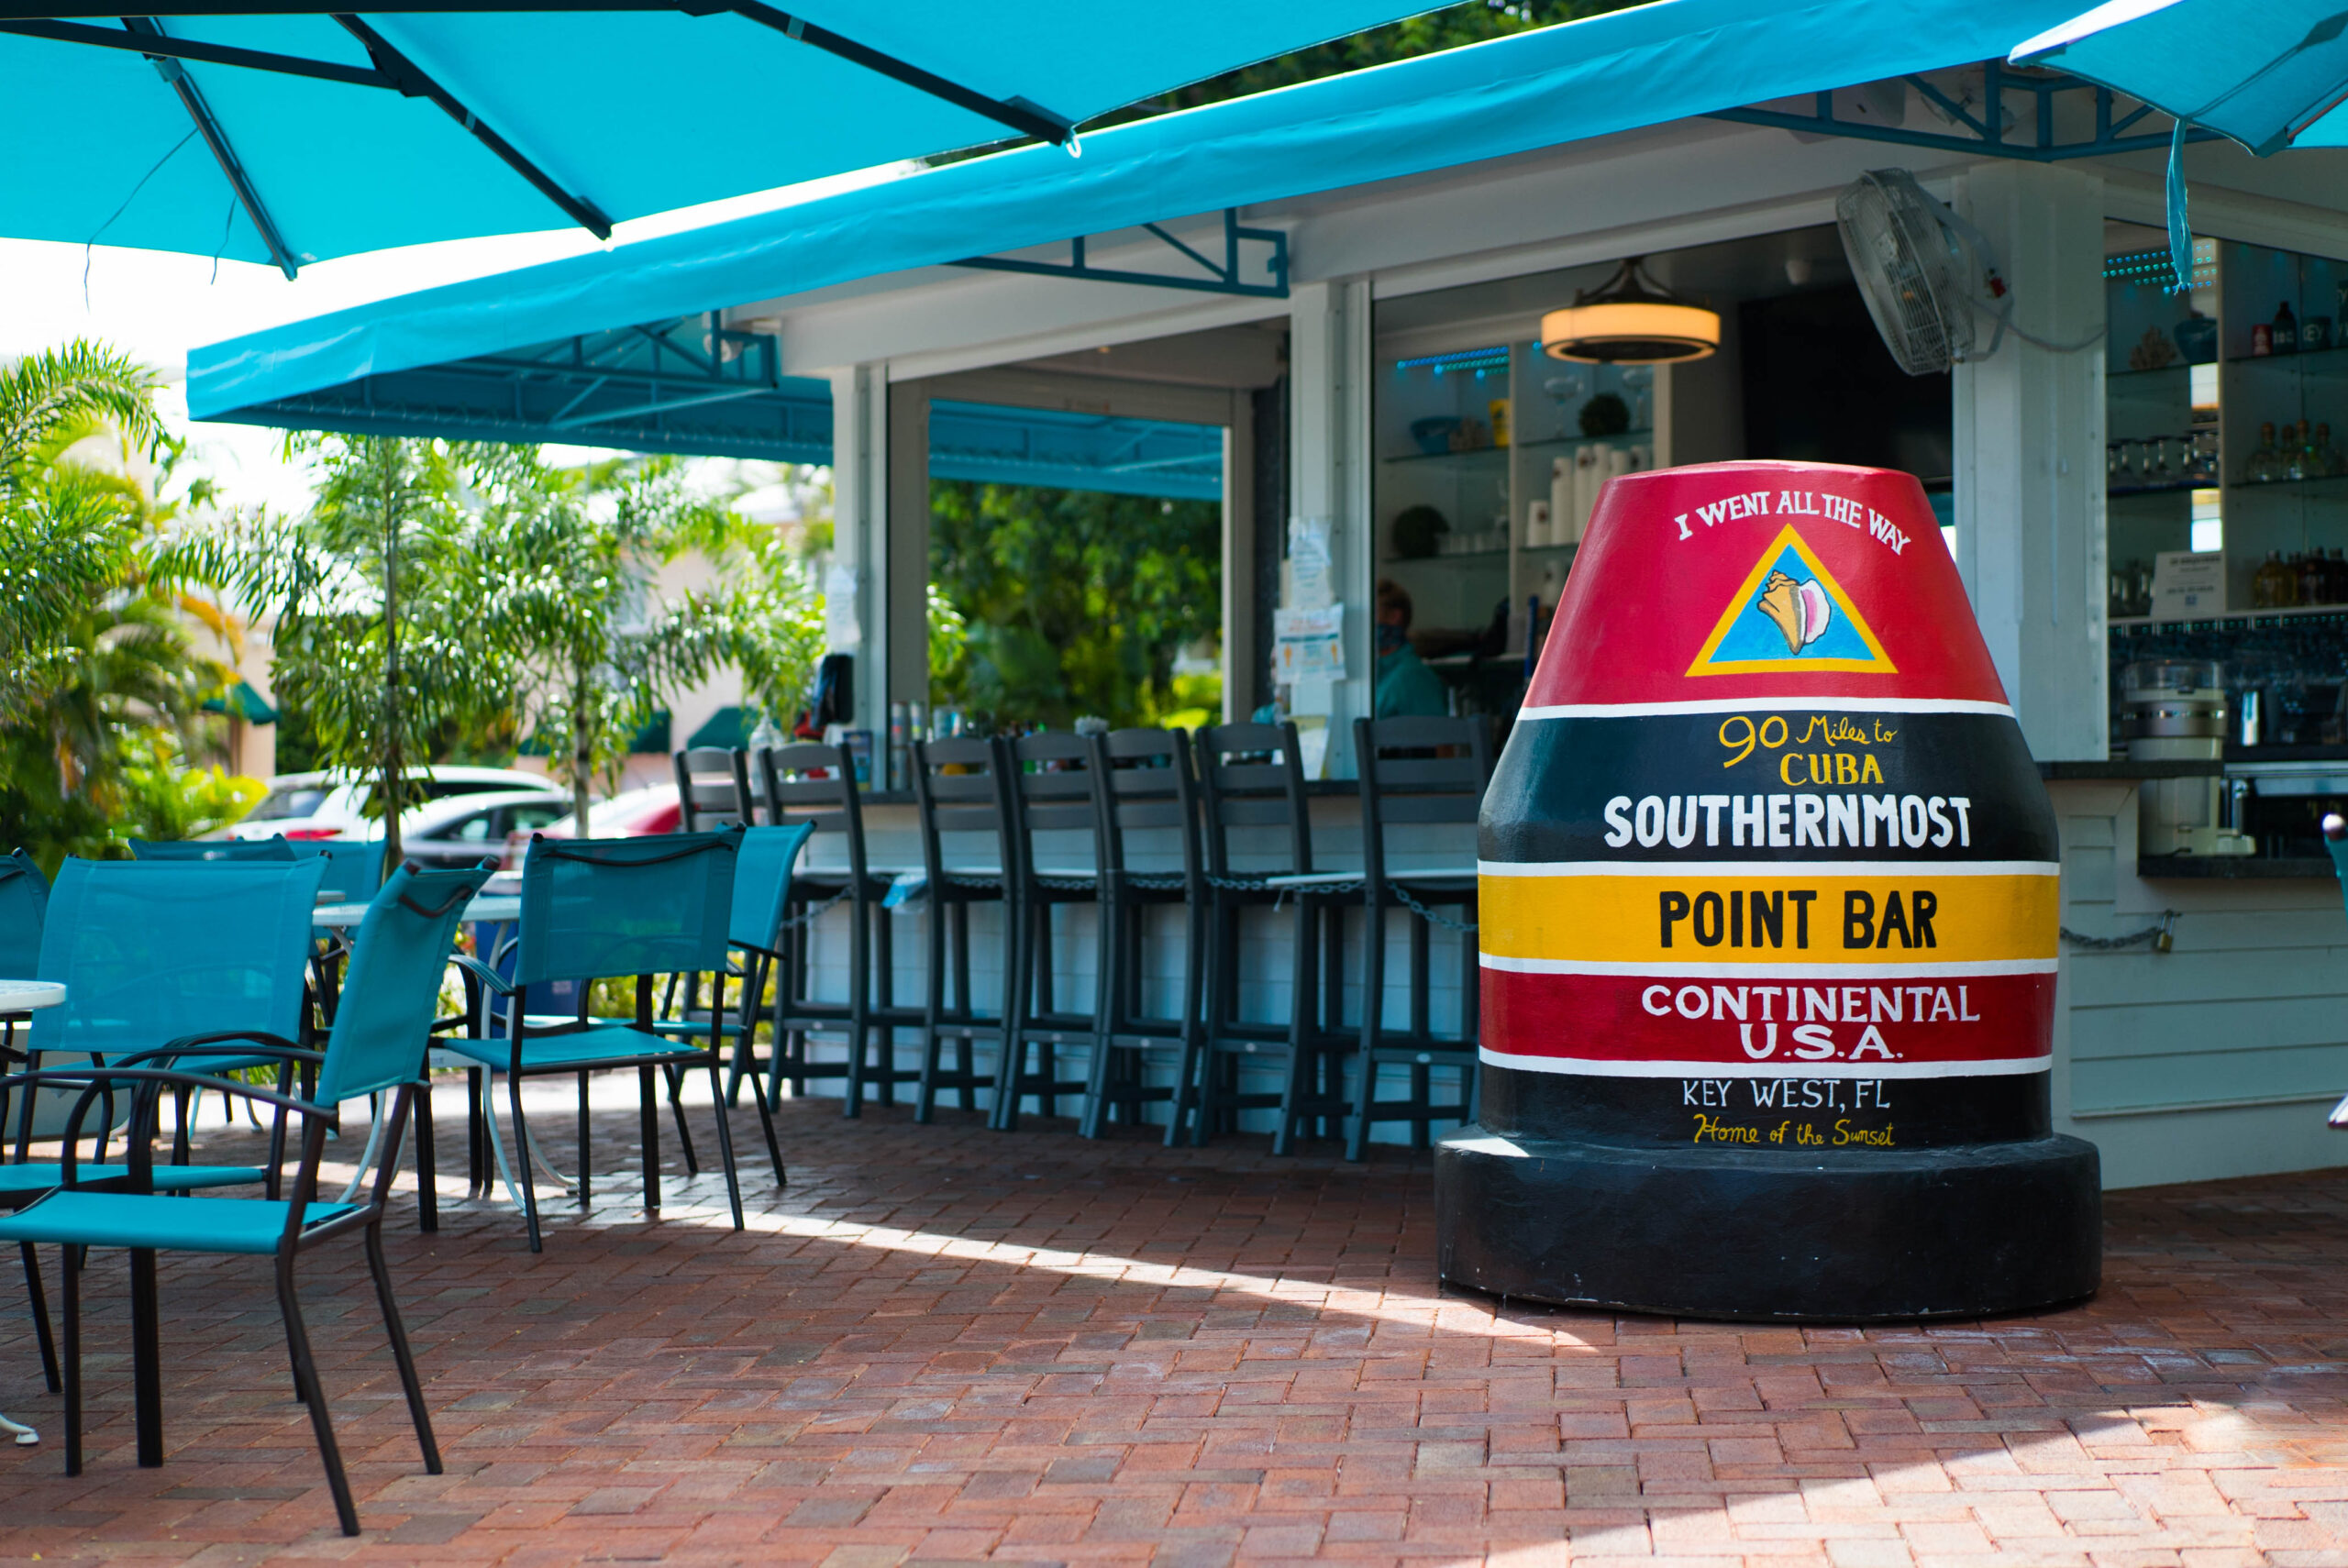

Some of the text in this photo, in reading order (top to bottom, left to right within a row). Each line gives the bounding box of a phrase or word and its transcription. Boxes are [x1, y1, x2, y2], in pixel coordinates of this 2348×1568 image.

[1674, 491, 1911, 556] I WENT ALL THE WAY
[1719, 715, 1899, 768] 90 Miles to
[1780, 753, 1884, 786] CUBA
[1603, 793, 1971, 849] SOUTHERNMOST
[1659, 890, 1938, 949] POINT BAR
[1641, 984, 1981, 1021] CONTINENTAL
[1740, 1024, 1904, 1059] U.S.A.
[1683, 1078, 1890, 1113] KEY WEST, FL
[1693, 1113, 1896, 1146] Home of the Sunset
